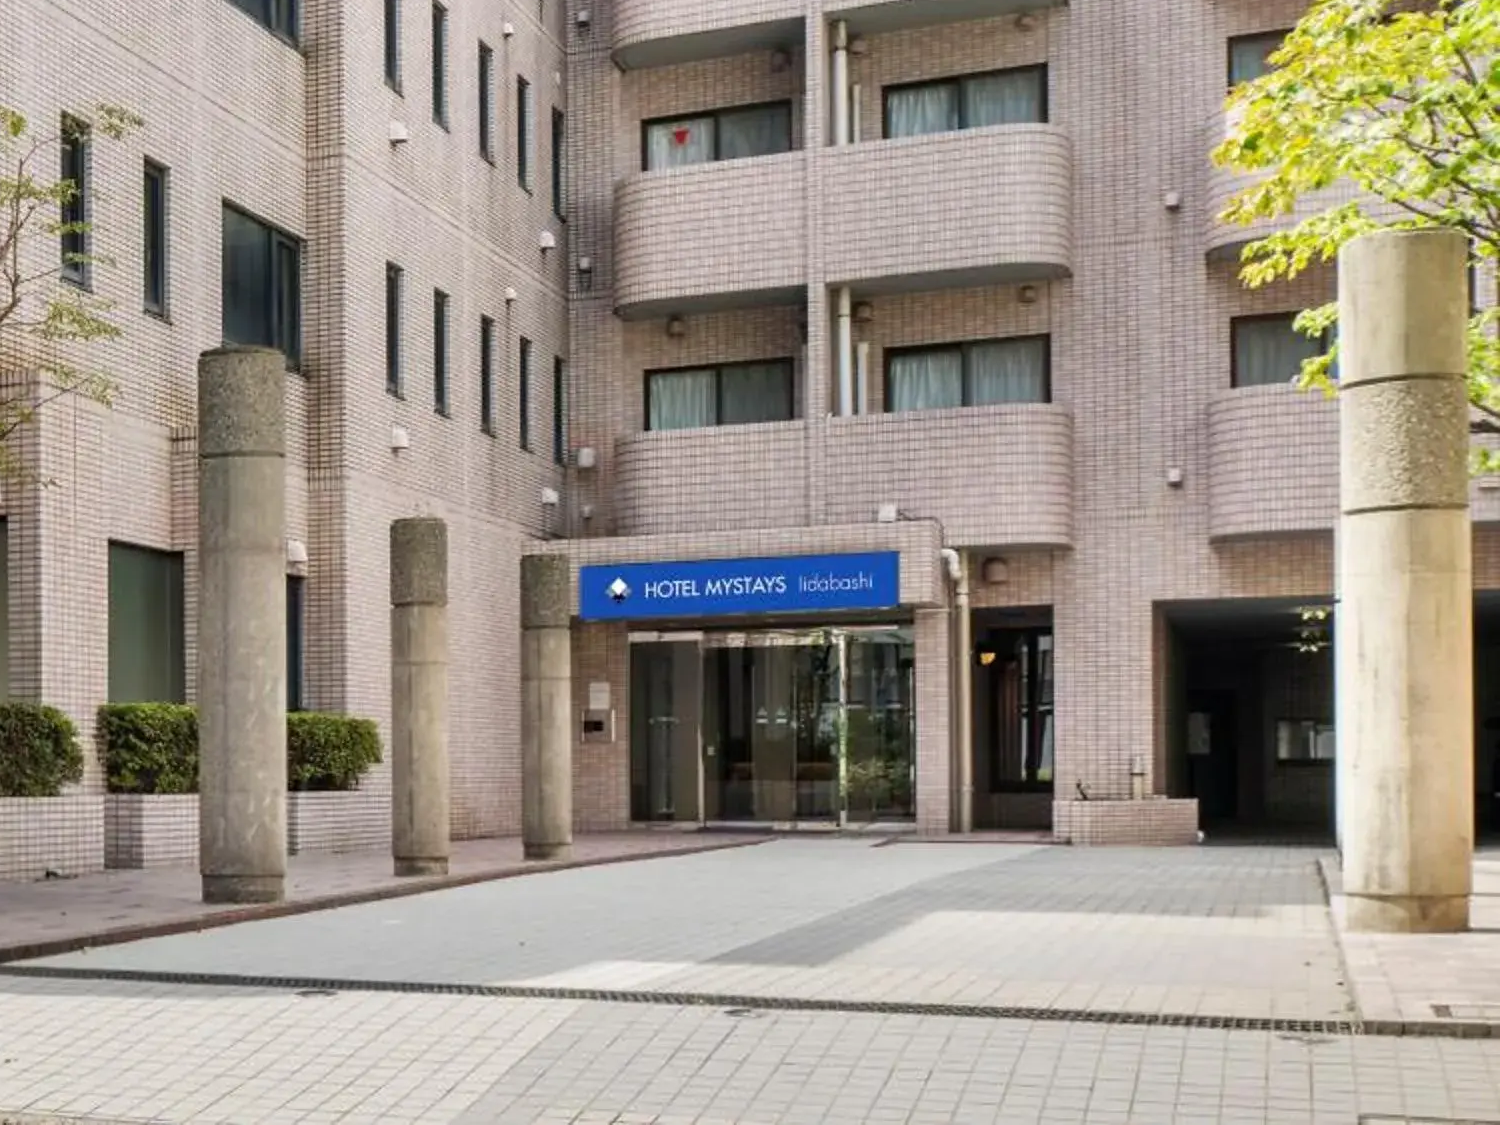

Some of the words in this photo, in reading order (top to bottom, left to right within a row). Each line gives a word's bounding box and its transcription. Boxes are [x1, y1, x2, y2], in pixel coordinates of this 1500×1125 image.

[645, 579, 700, 598] HOTEL
[705, 574, 787, 595] MYSTAYS
[799, 571, 873, 593] Iidabashi
